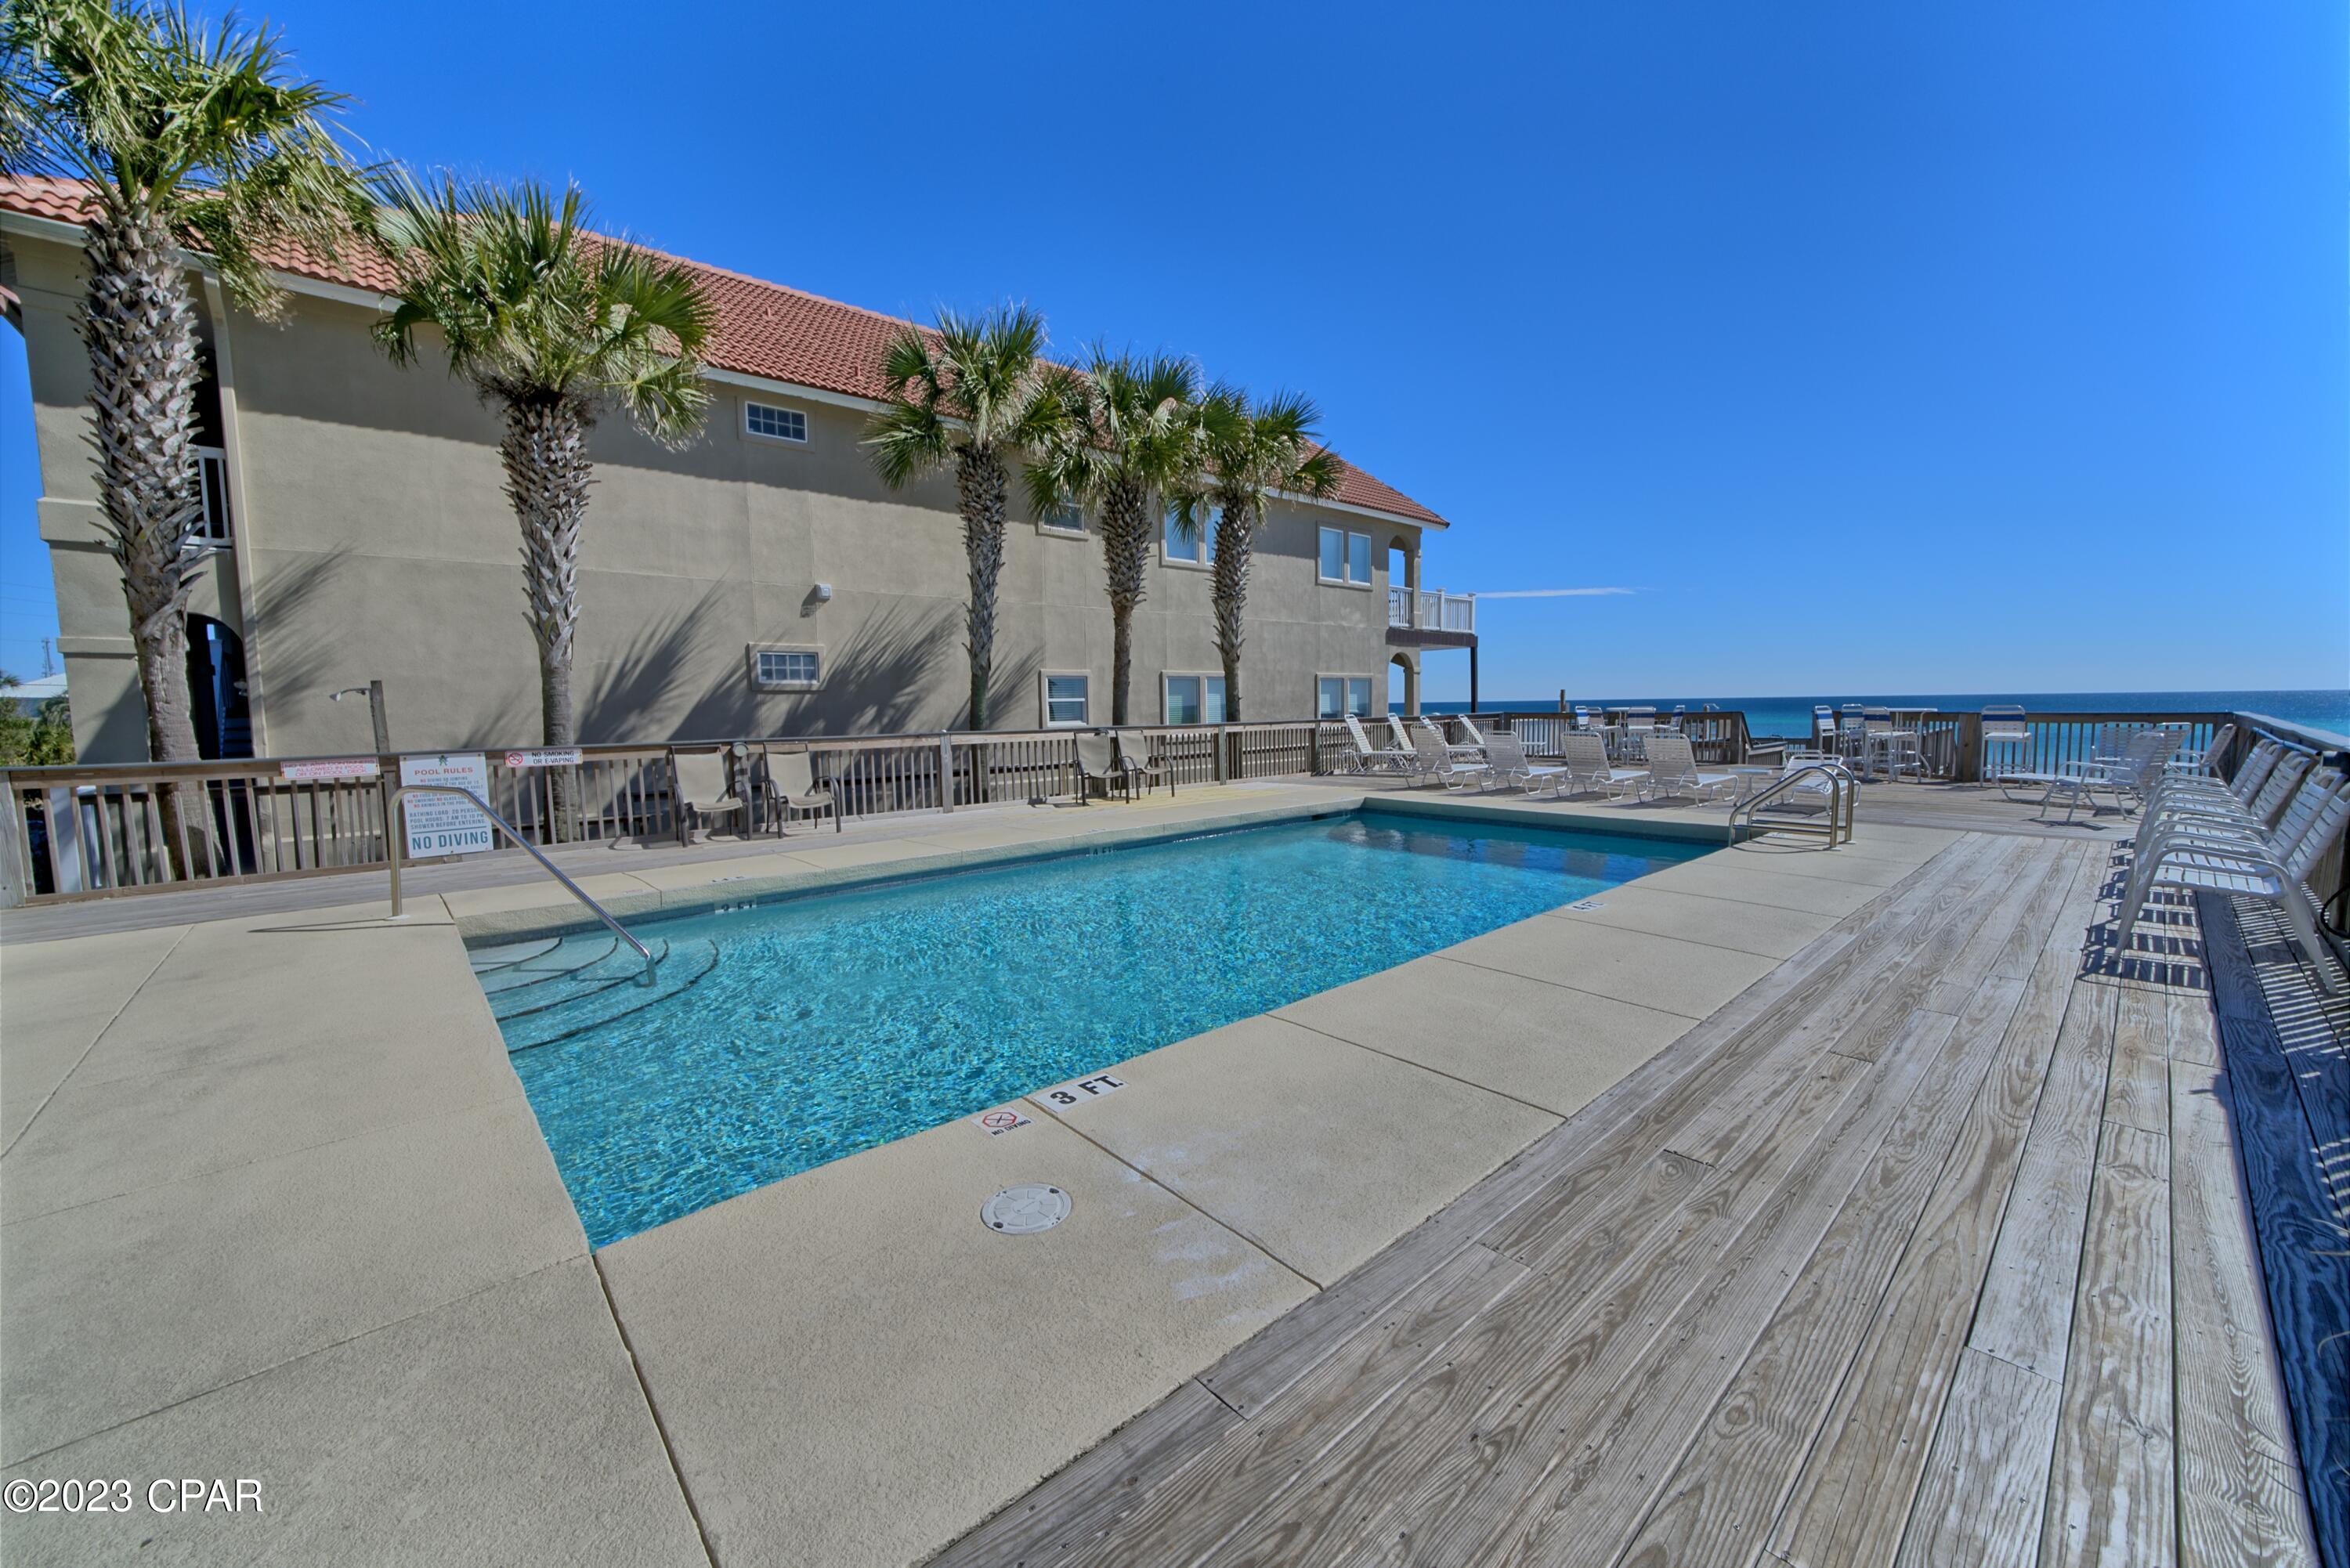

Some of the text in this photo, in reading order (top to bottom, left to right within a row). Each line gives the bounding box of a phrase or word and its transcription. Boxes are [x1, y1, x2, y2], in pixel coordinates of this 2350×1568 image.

[412, 830, 488, 850] NO DIVING
[1050, 1075, 1125, 1105] 3 FT.
[1006, 1119, 1032, 1132] DIVING
